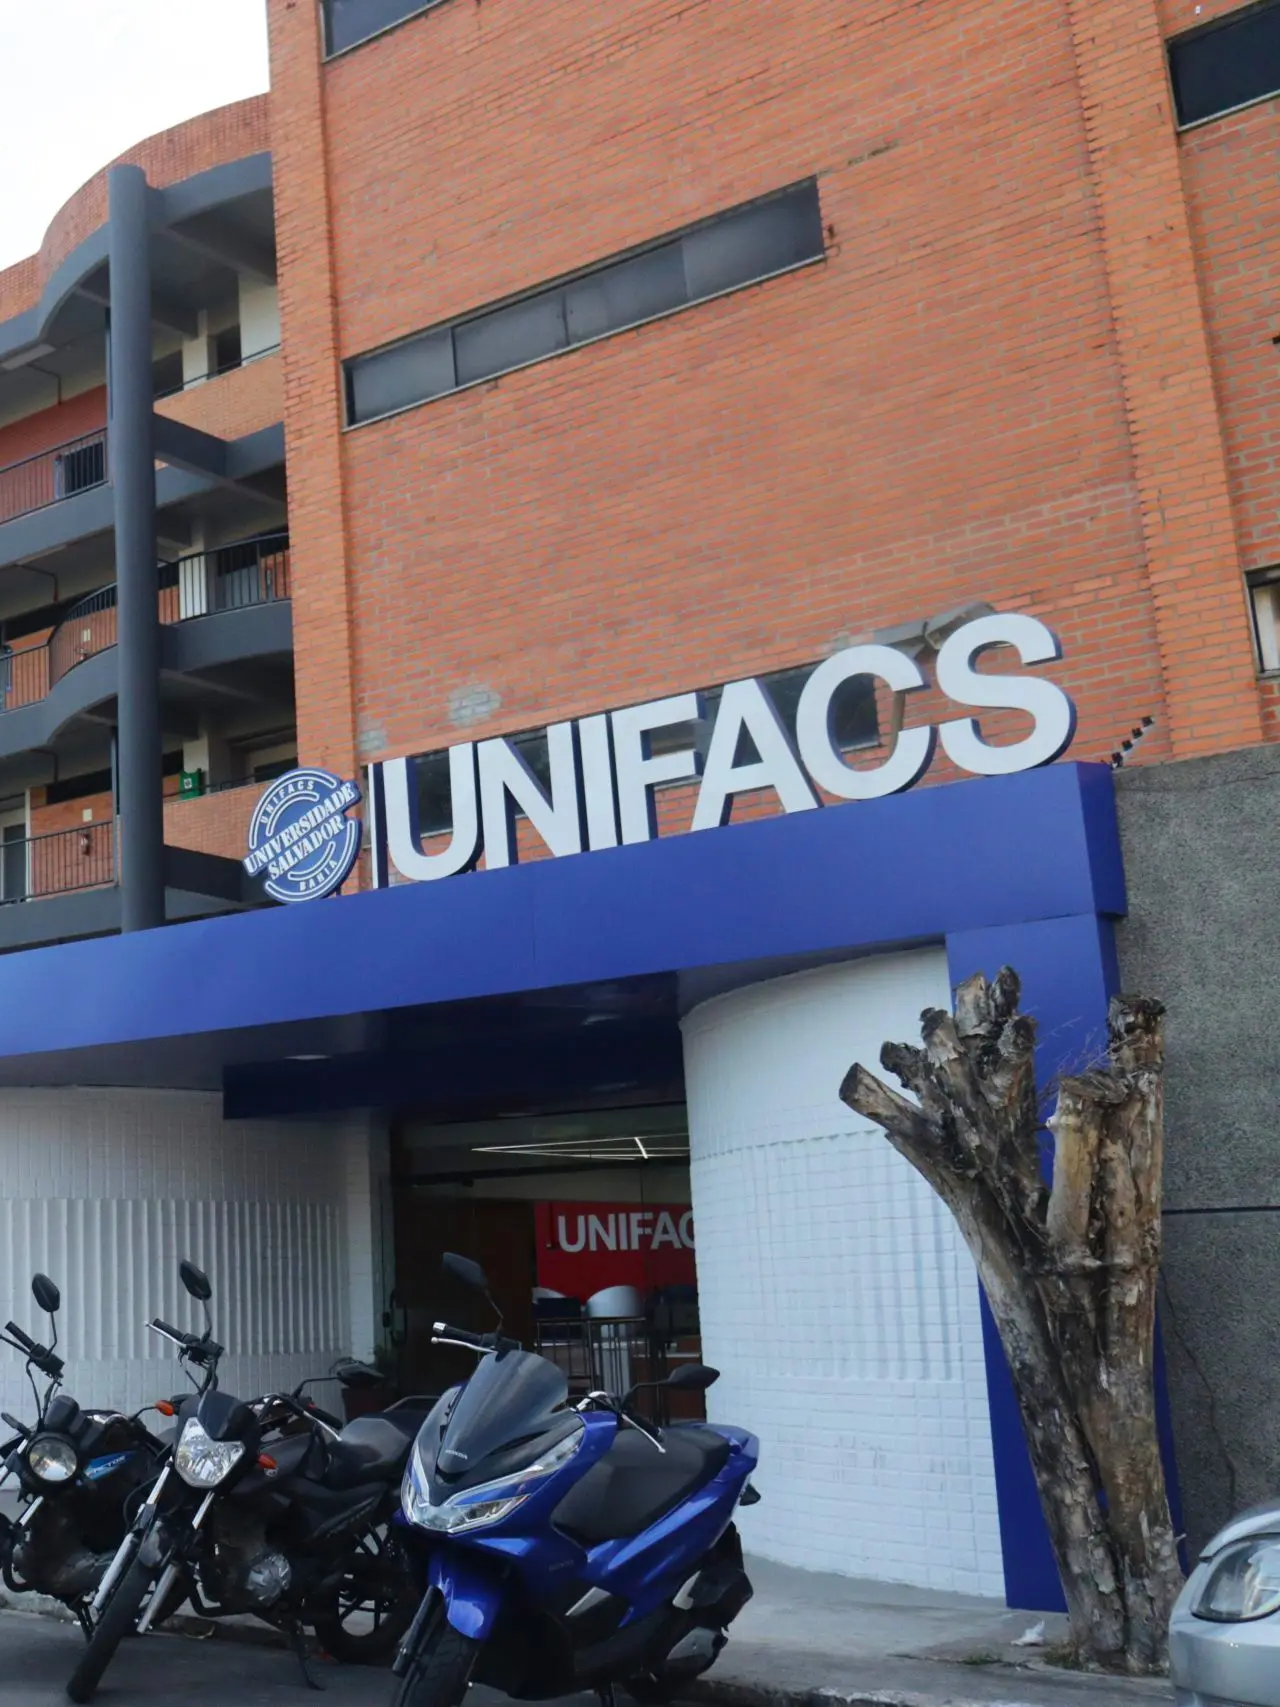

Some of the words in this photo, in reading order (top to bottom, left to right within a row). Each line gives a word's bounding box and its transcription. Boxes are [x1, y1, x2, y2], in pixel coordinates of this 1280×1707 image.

[382, 612, 1075, 882] UNIFACS
[243, 781, 355, 873] UNIVERSIDADE
[260, 780, 315, 824] UNIFACS
[267, 813, 345, 881] SALVADOR
[299, 859, 338, 891] BAHIA
[557, 1211, 696, 1253] UNIFAC
